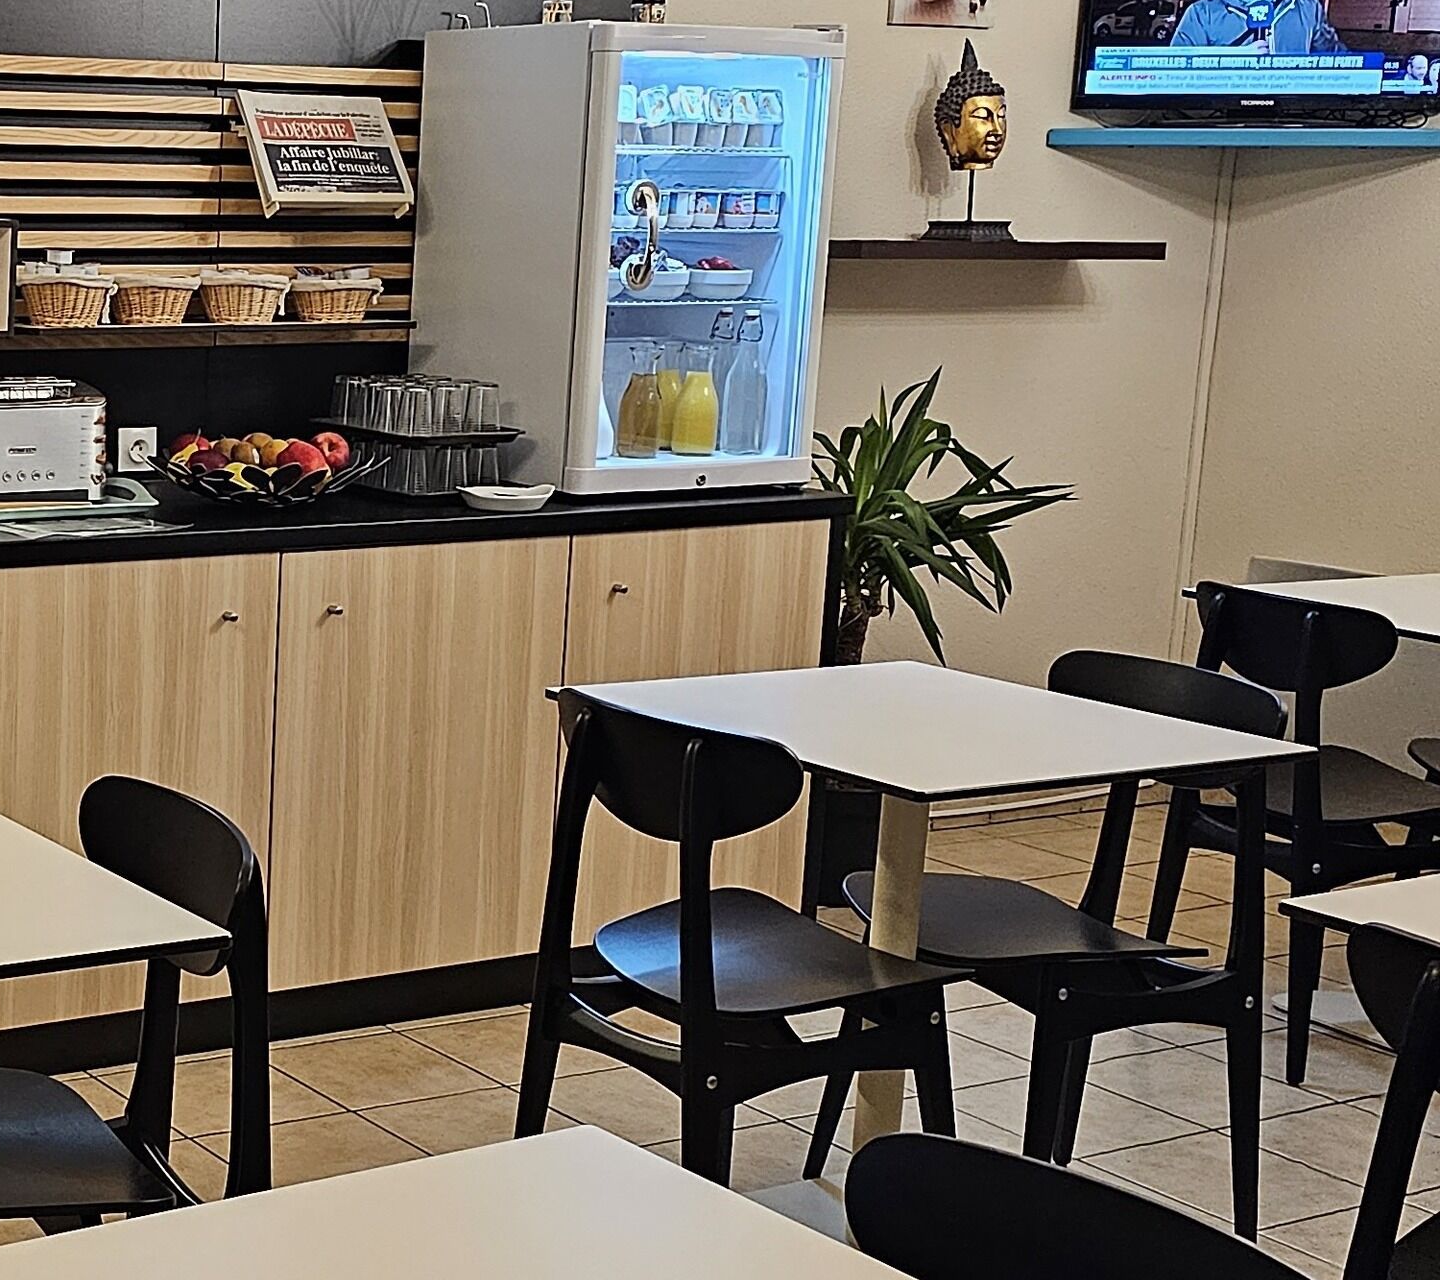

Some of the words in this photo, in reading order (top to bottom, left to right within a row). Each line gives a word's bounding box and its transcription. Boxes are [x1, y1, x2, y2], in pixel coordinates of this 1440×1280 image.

[280, 146, 326, 159] Affaire
[276, 160, 292, 172] la
[292, 160, 312, 172] fin
[312, 161, 329, 172] de
